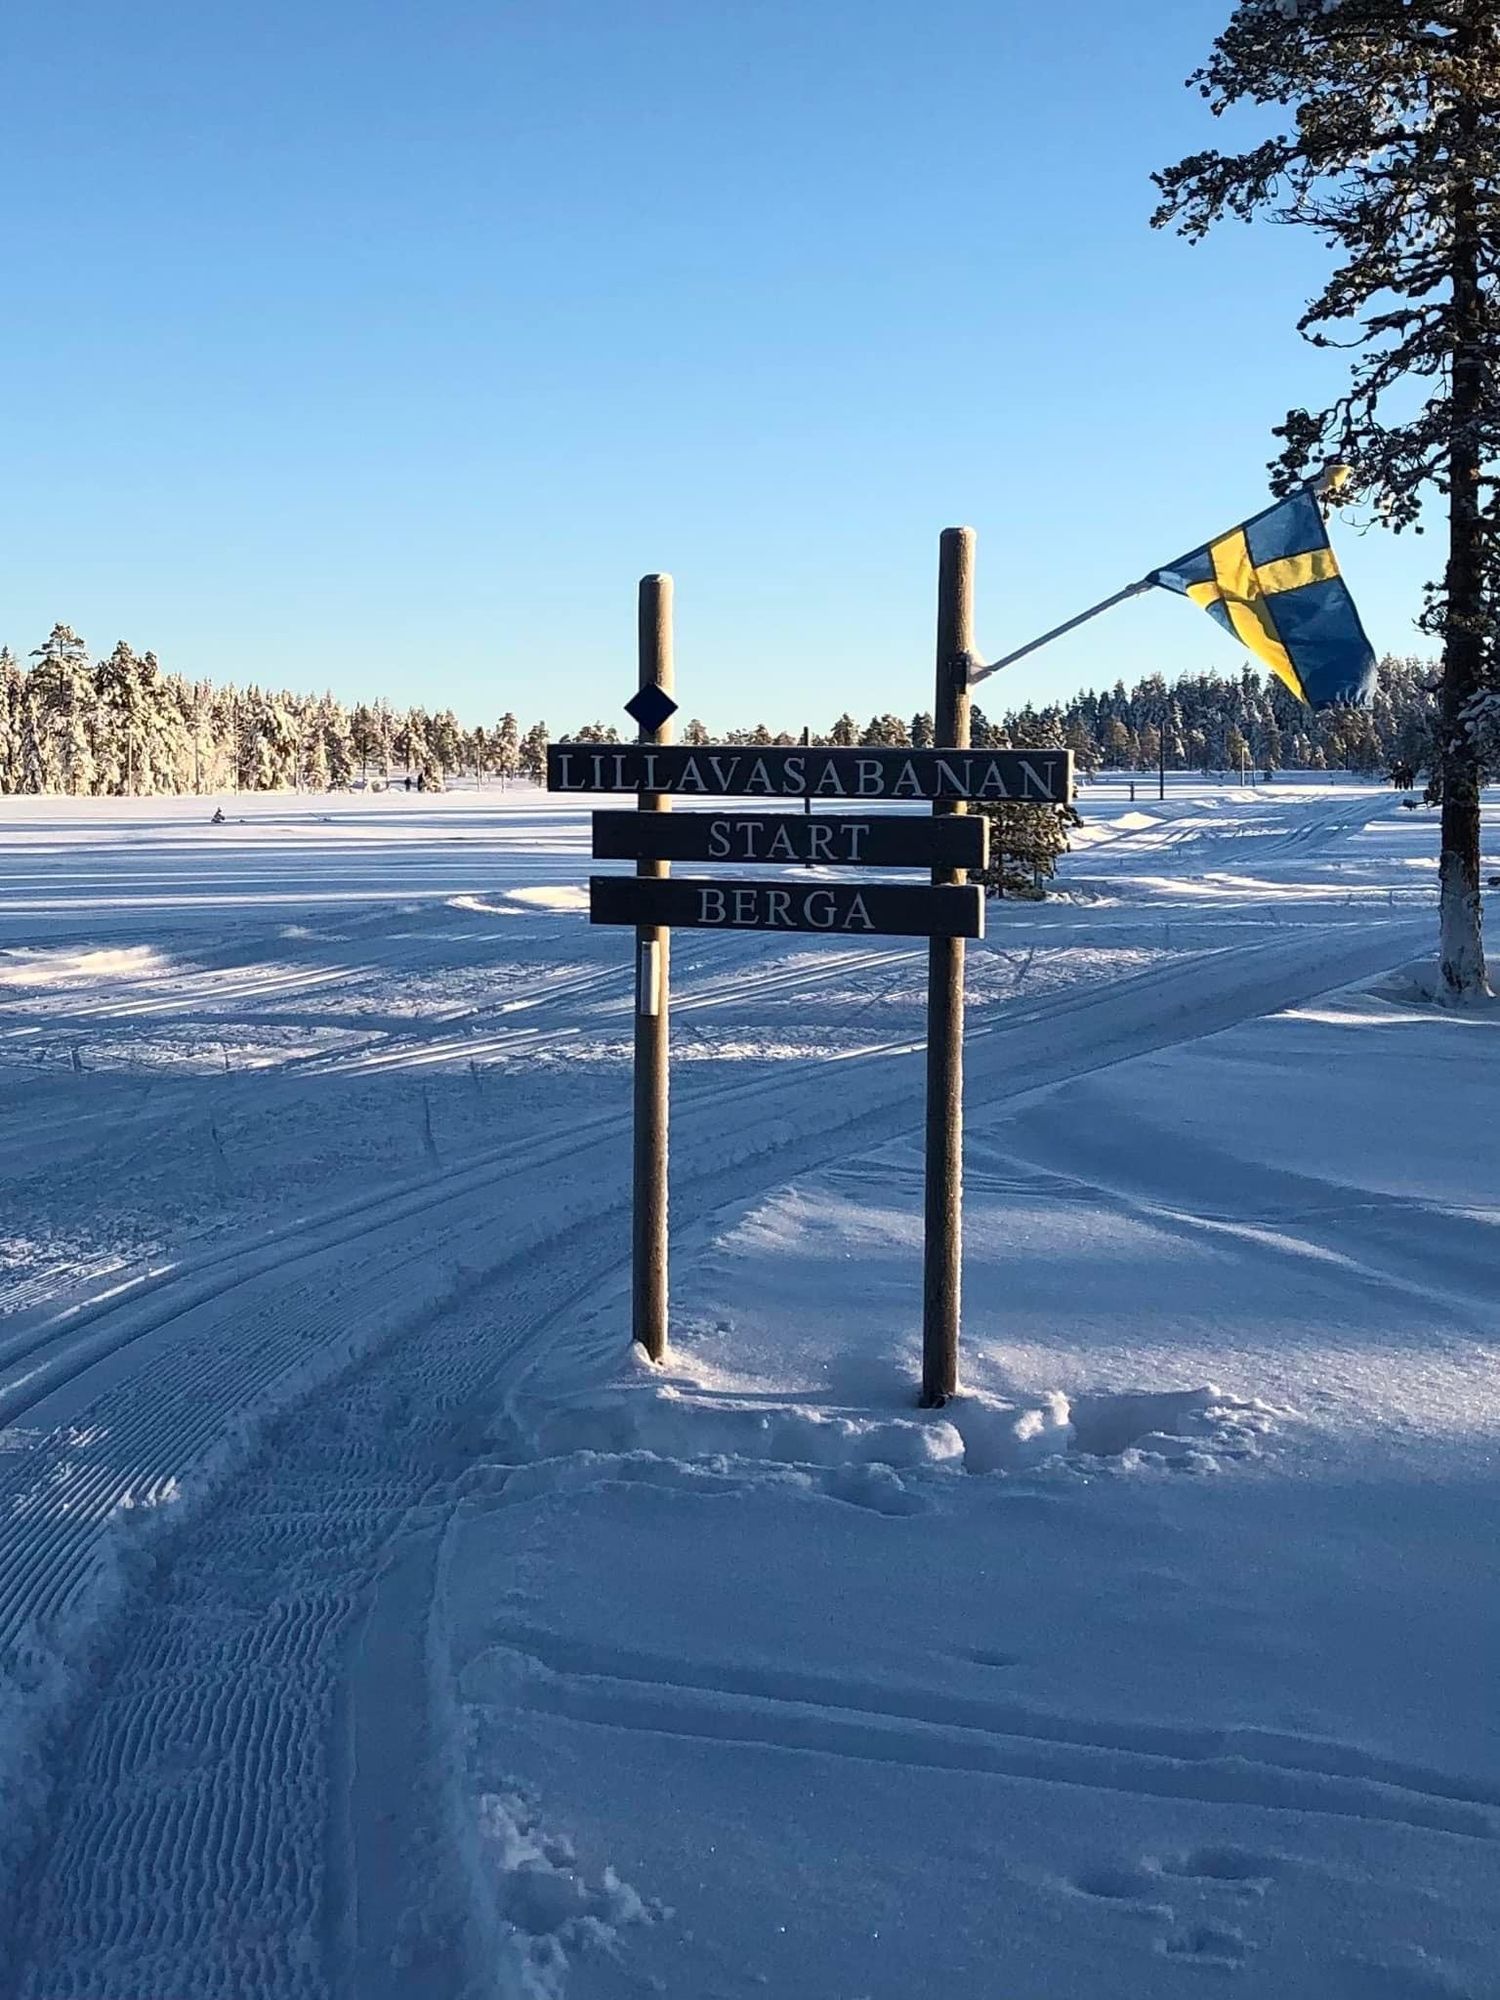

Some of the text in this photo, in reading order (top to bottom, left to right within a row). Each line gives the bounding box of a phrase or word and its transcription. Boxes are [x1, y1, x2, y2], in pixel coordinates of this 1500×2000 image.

[558, 754, 1057, 799] LILLAVASABANAN
[708, 820, 870, 861] START
[697, 888, 876, 929] BERGA
